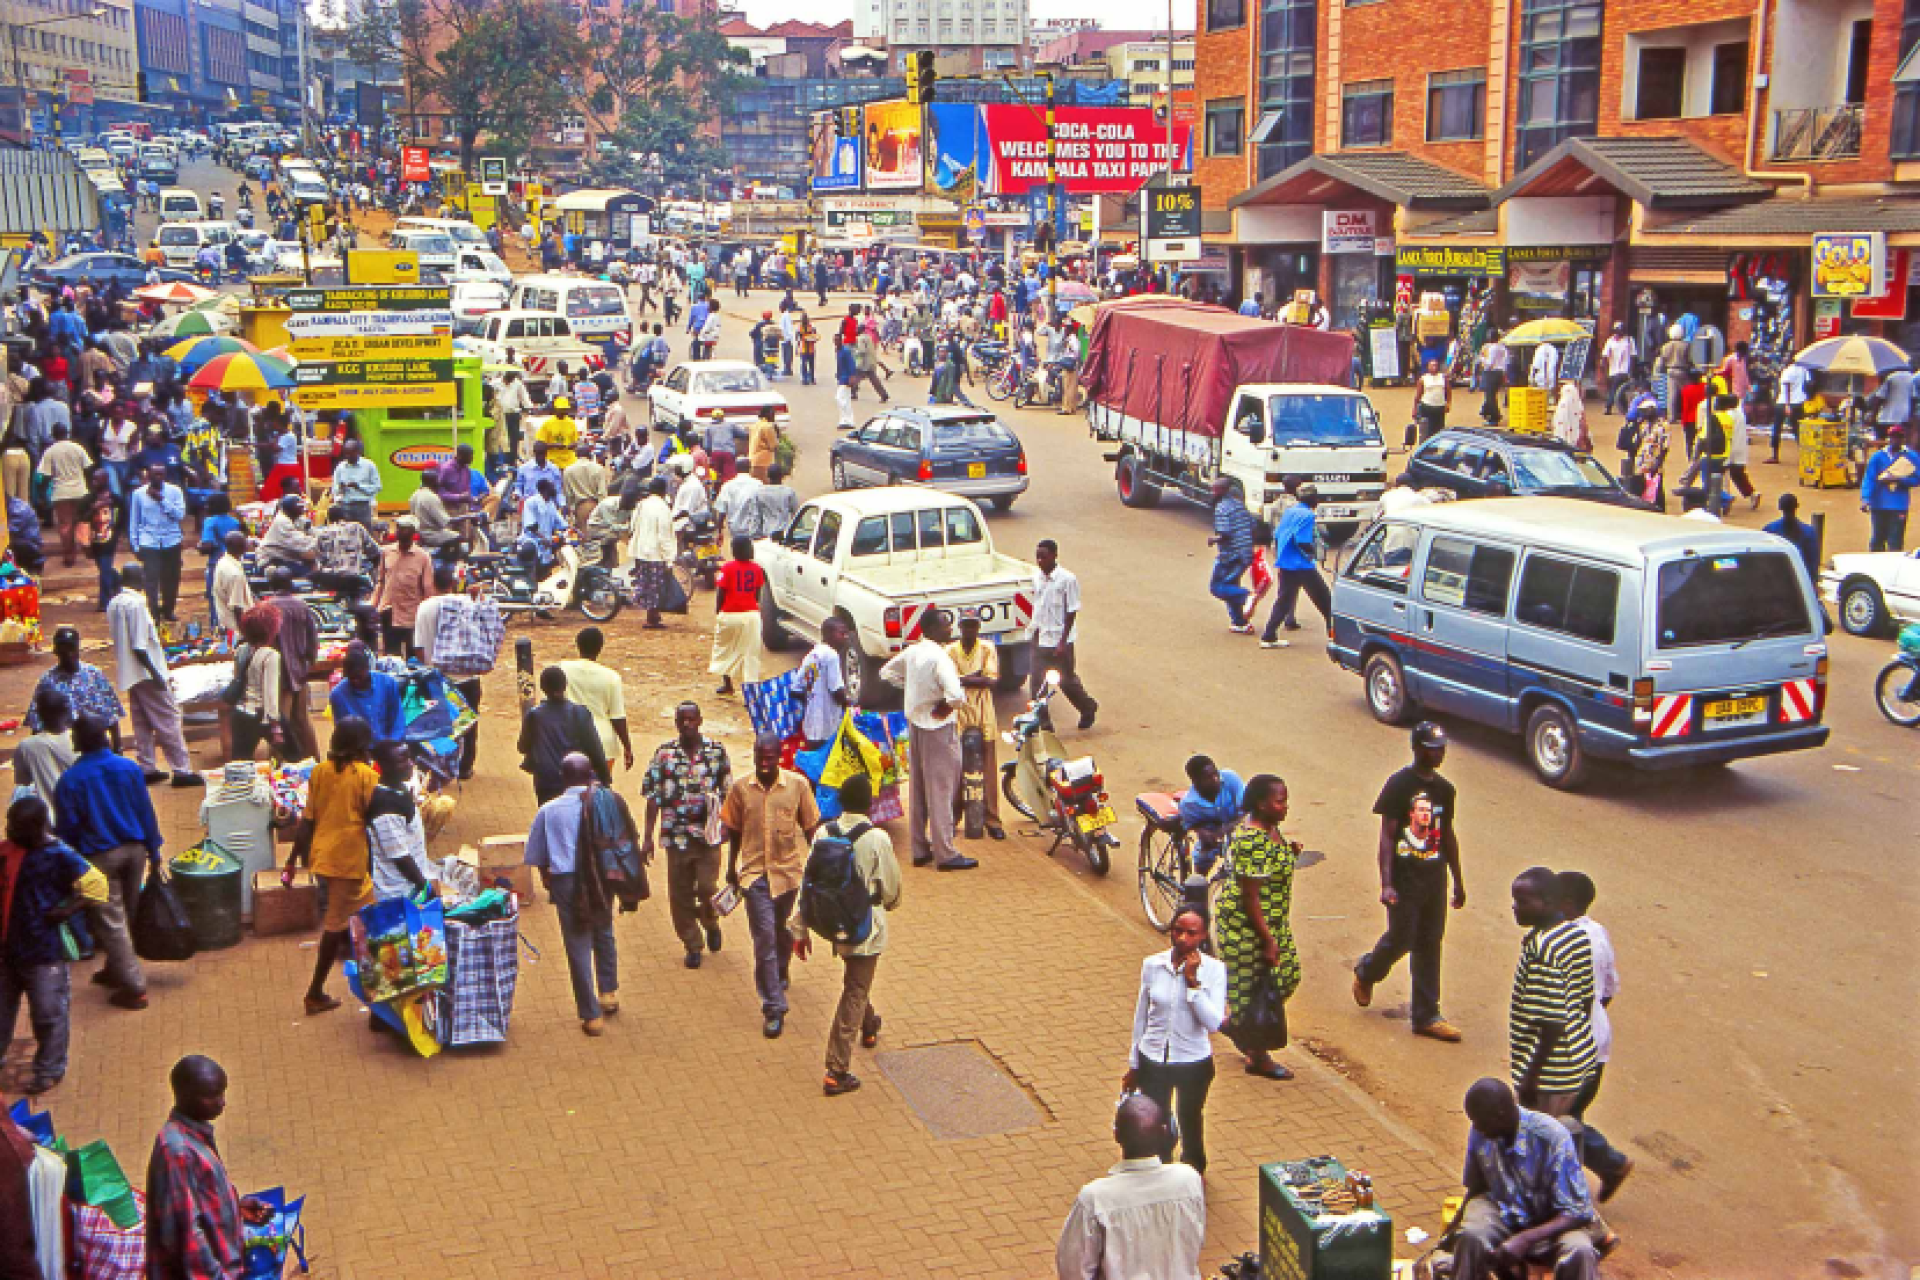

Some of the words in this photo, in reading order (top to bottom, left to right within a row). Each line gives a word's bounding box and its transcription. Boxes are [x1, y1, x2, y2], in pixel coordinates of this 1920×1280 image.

[1047, 18, 1102, 28] HOTEL
[1000, 141, 1091, 158] WELCMES
[1094, 143, 1126, 158] YOU
[1129, 143, 1149, 158] TO
[1152, 143, 1181, 159] THE
[1092, 162, 1125, 177] TAXI
[1154, 193, 1195, 212] 10%
[310, 315, 348, 325] KAMPALA
[349, 314, 367, 325] CITY
[1312, 474, 1351, 483] ISUZU
[736, 570, 755, 591] 12
